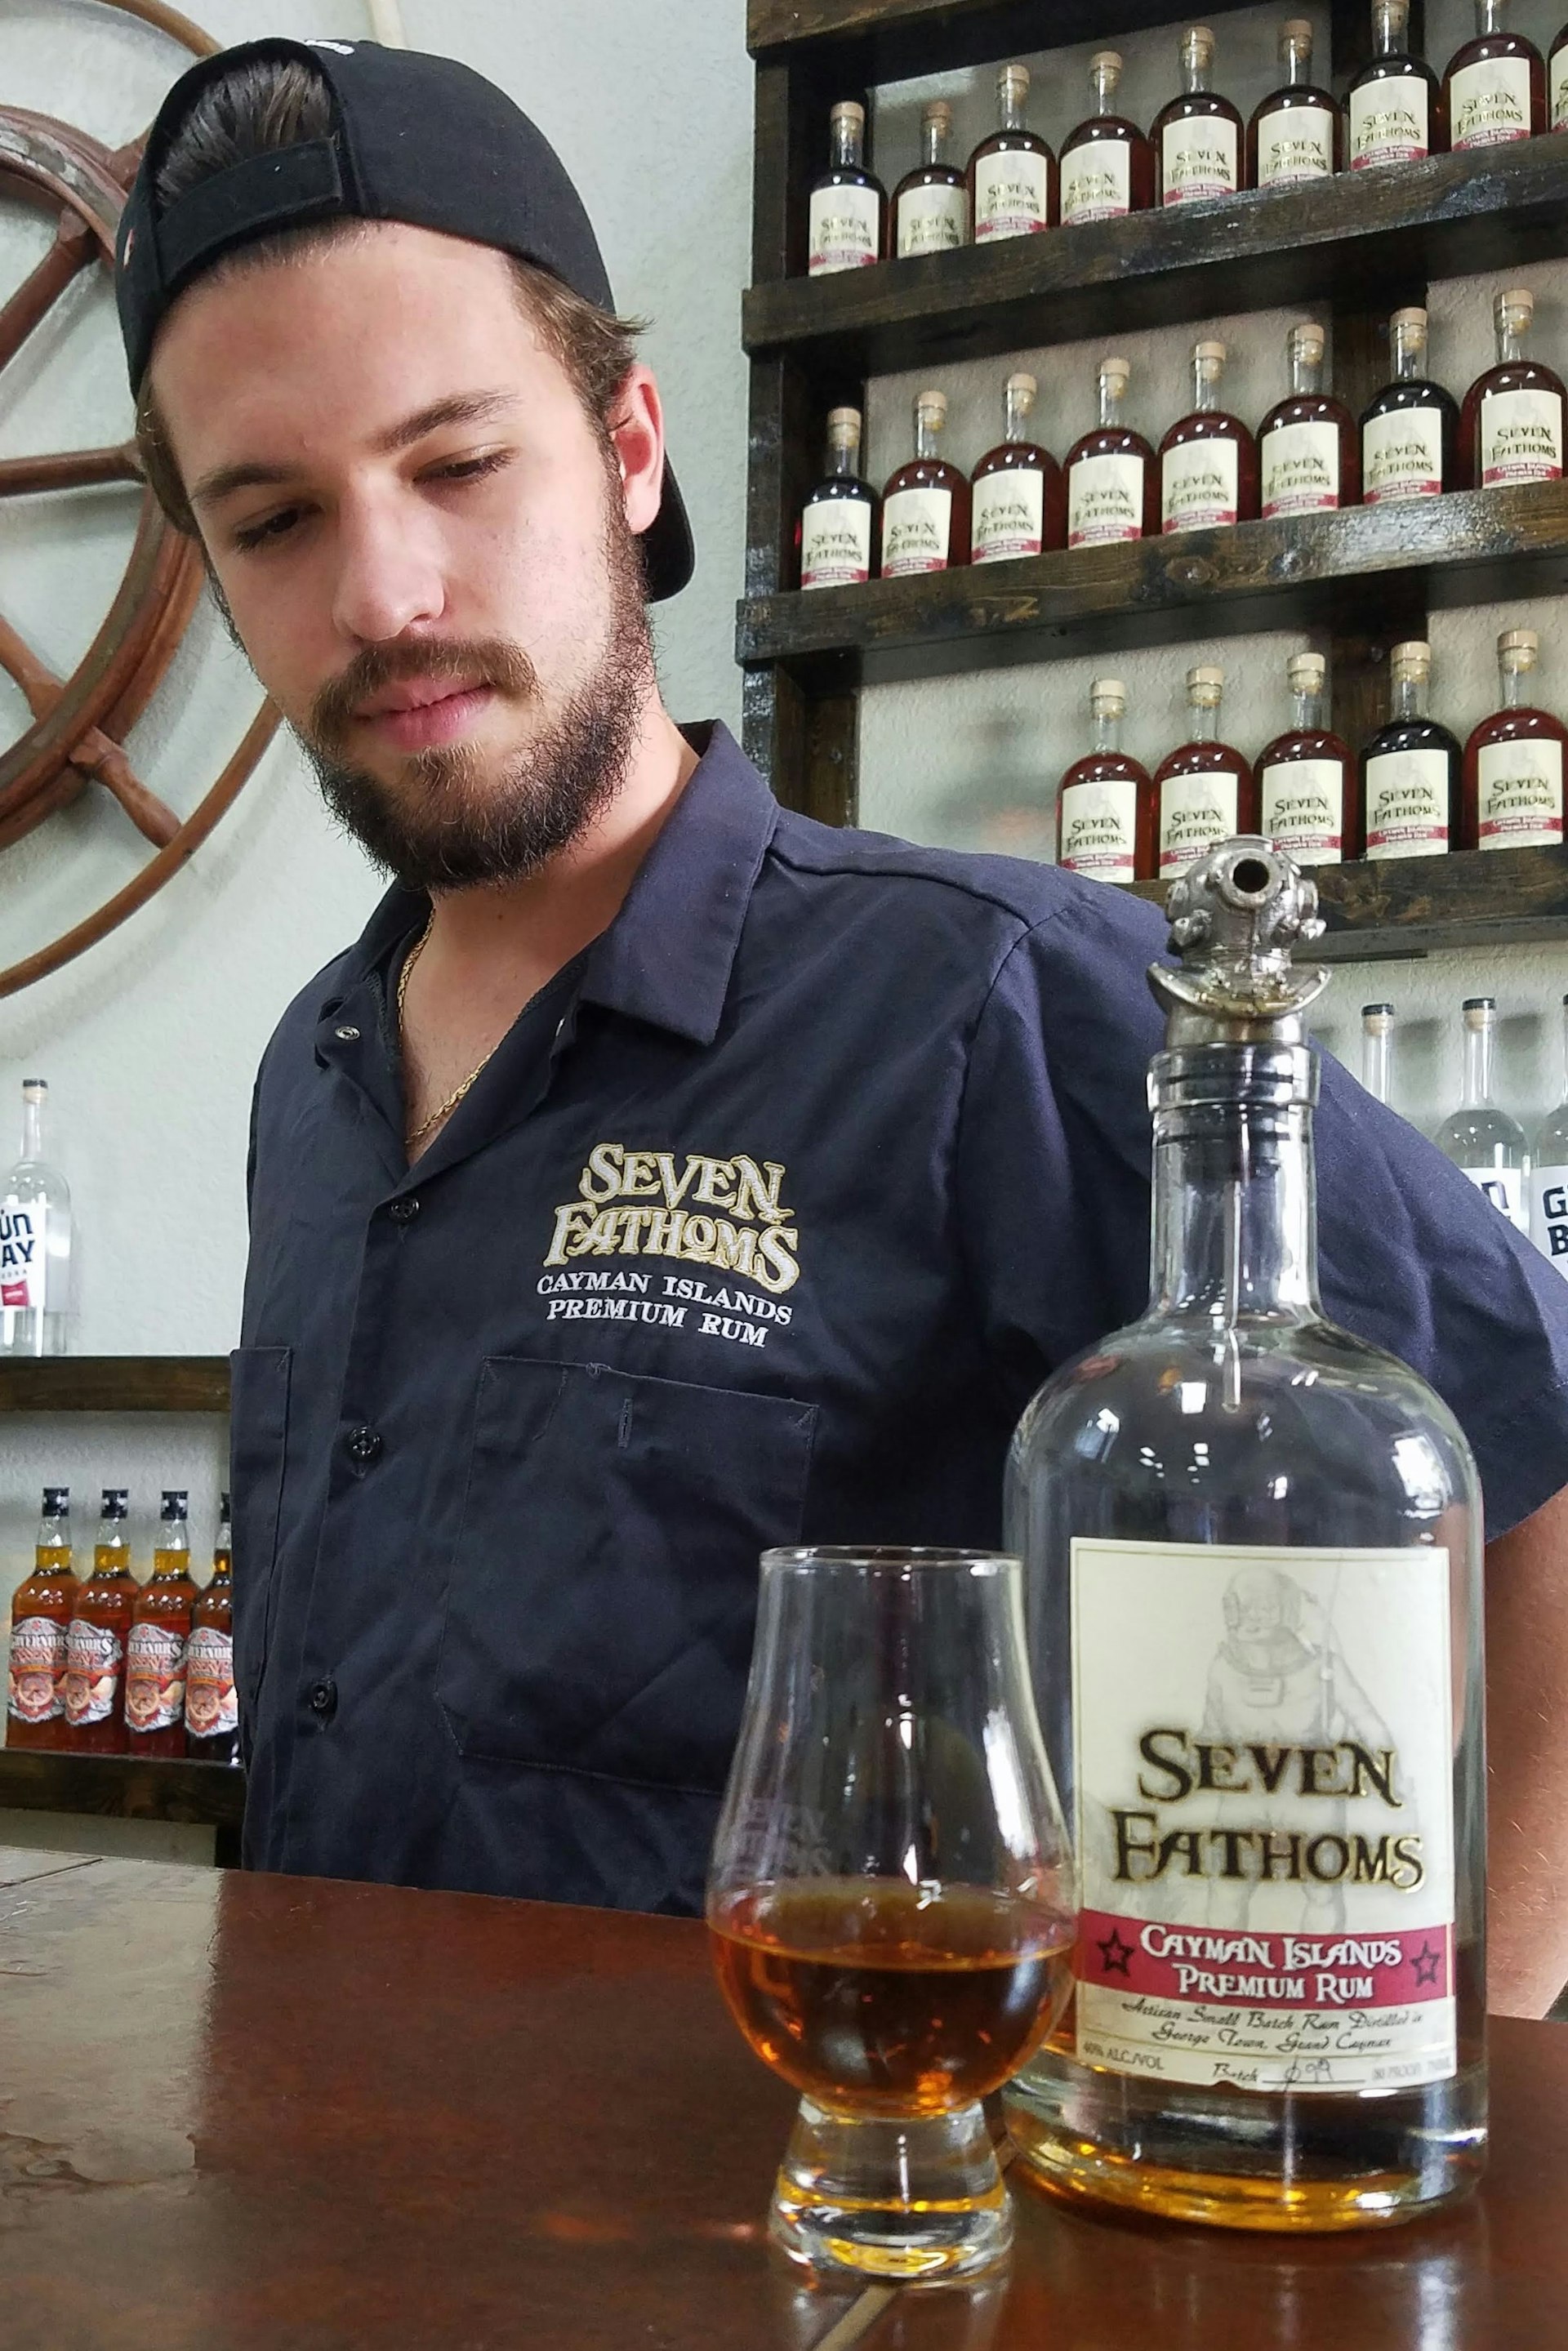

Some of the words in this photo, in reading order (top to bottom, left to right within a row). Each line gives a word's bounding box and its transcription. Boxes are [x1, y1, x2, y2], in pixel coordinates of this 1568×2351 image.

[1463, 92, 1517, 114] SEVEN
[1362, 109, 1416, 129] SEVEN
[1496, 426, 1552, 443] SEVEN
[1491, 443, 1557, 462] FATHOMS
[1379, 786, 1433, 807] SEVEN
[1492, 777, 1548, 797] SEVEN
[1274, 796, 1329, 815] SEVEN
[1487, 795, 1555, 814] FATHOMS
[1171, 808, 1223, 827] SEVEN
[1269, 815, 1334, 834] FATHOMS
[1374, 805, 1441, 825] FATHOMS
[1071, 817, 1121, 835] SEVEN
[1067, 834, 1127, 853] FATHOMS
[578, 1142, 795, 1225] SEVEN
[542, 1200, 802, 1294] FATHOMS
[537, 1271, 653, 1296] CAYMAN
[661, 1275, 794, 1326] ISLANDS
[546, 1297, 688, 1329] PREMIUM
[697, 1311, 769, 1349] RUM
[1138, 1728, 1403, 1807] SEVEN
[1109, 1808, 1425, 1893] FATHOMS
[1140, 1924, 1276, 1969] CAYMAN
[1282, 1936, 1403, 1971] ISLANDS
[1171, 1962, 1306, 1998] PREMIUM
[1315, 1973, 1374, 2004] RUM
[1187, 2005, 1240, 2026] Small
[1246, 2010, 1294, 2030] Batch
[1302, 2013, 1339, 2031] Rum
[1152, 2020, 1210, 2047] George
[1276, 2032, 1330, 2053] Grand
[1214, 2063, 1258, 2082] Batch
